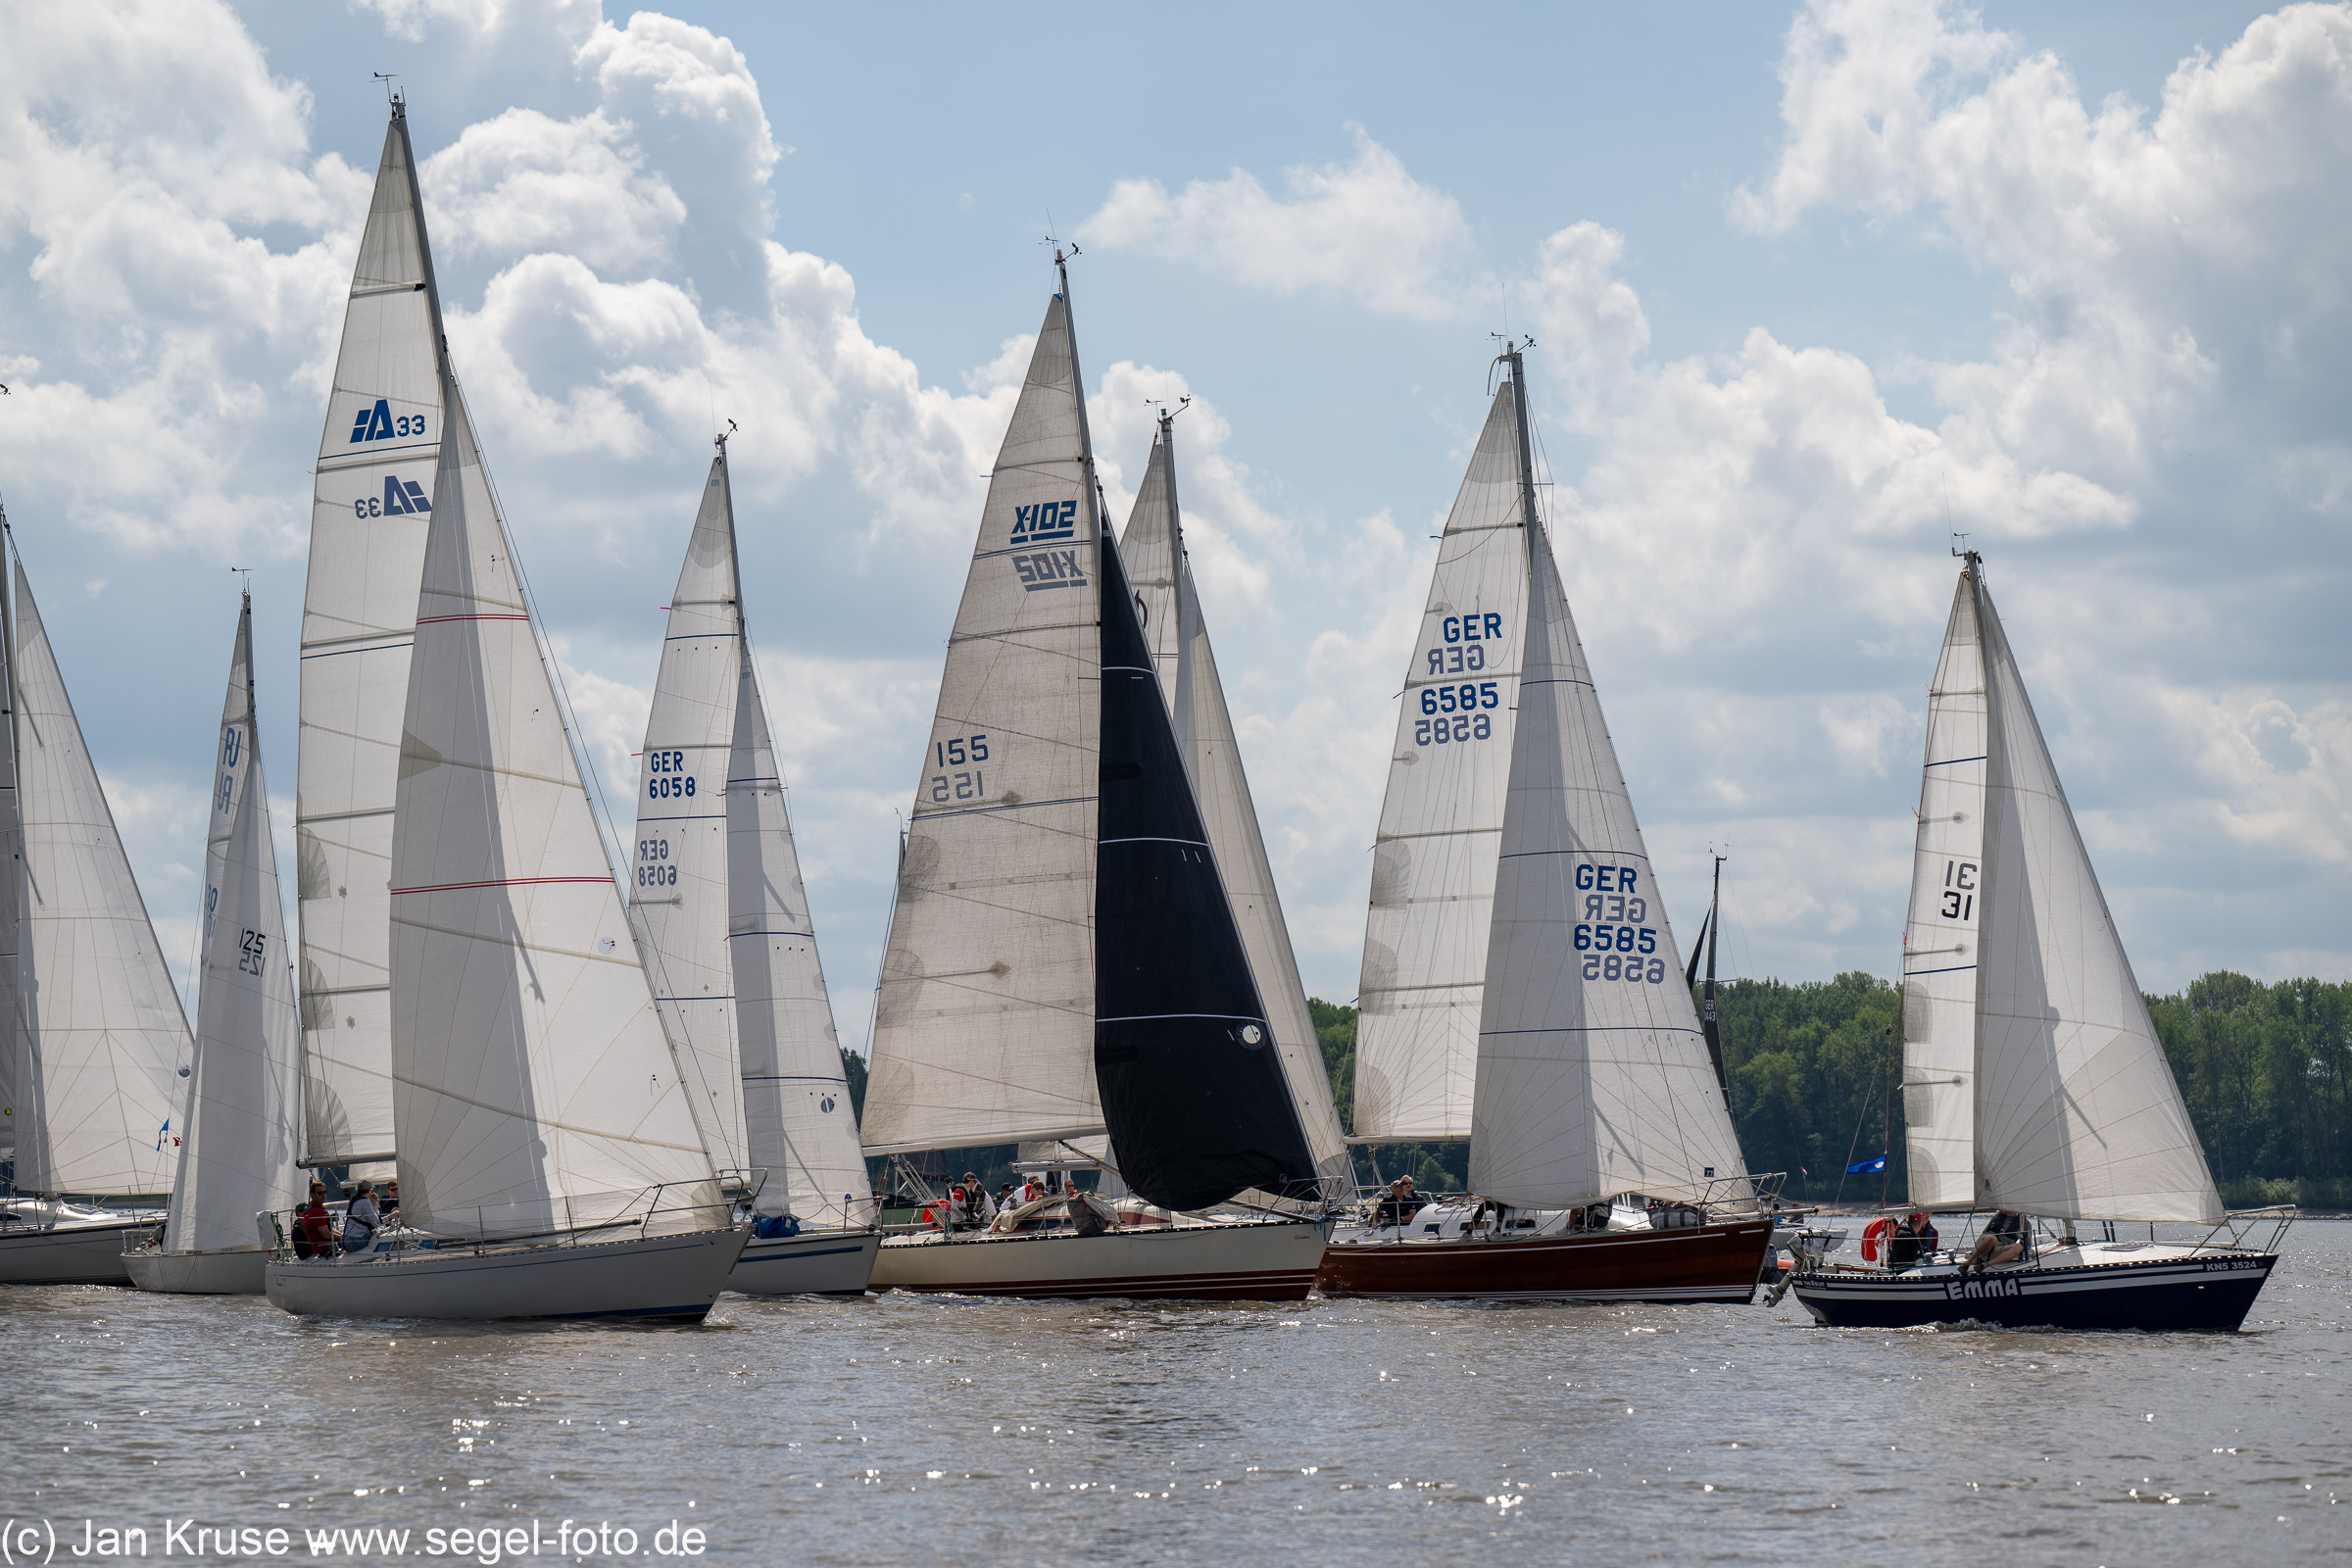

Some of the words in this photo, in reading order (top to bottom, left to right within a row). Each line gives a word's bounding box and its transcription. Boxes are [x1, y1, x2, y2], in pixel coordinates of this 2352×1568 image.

[1443, 612, 1502, 643] GER
[1420, 682, 1498, 715] 6585
[651, 751, 684, 773] GER
[937, 734, 989, 767] 155
[649, 776, 696, 799] 6058
[1576, 863, 1638, 894] GER
[1941, 890, 1973, 921] 31
[238, 927, 267, 956] 125
[1573, 924, 1657, 955] 6585
[1705, 999, 1715, 1010] GER
[2230, 1260, 2257, 1270] 3524
[1946, 1278, 2019, 1300] EMMA
